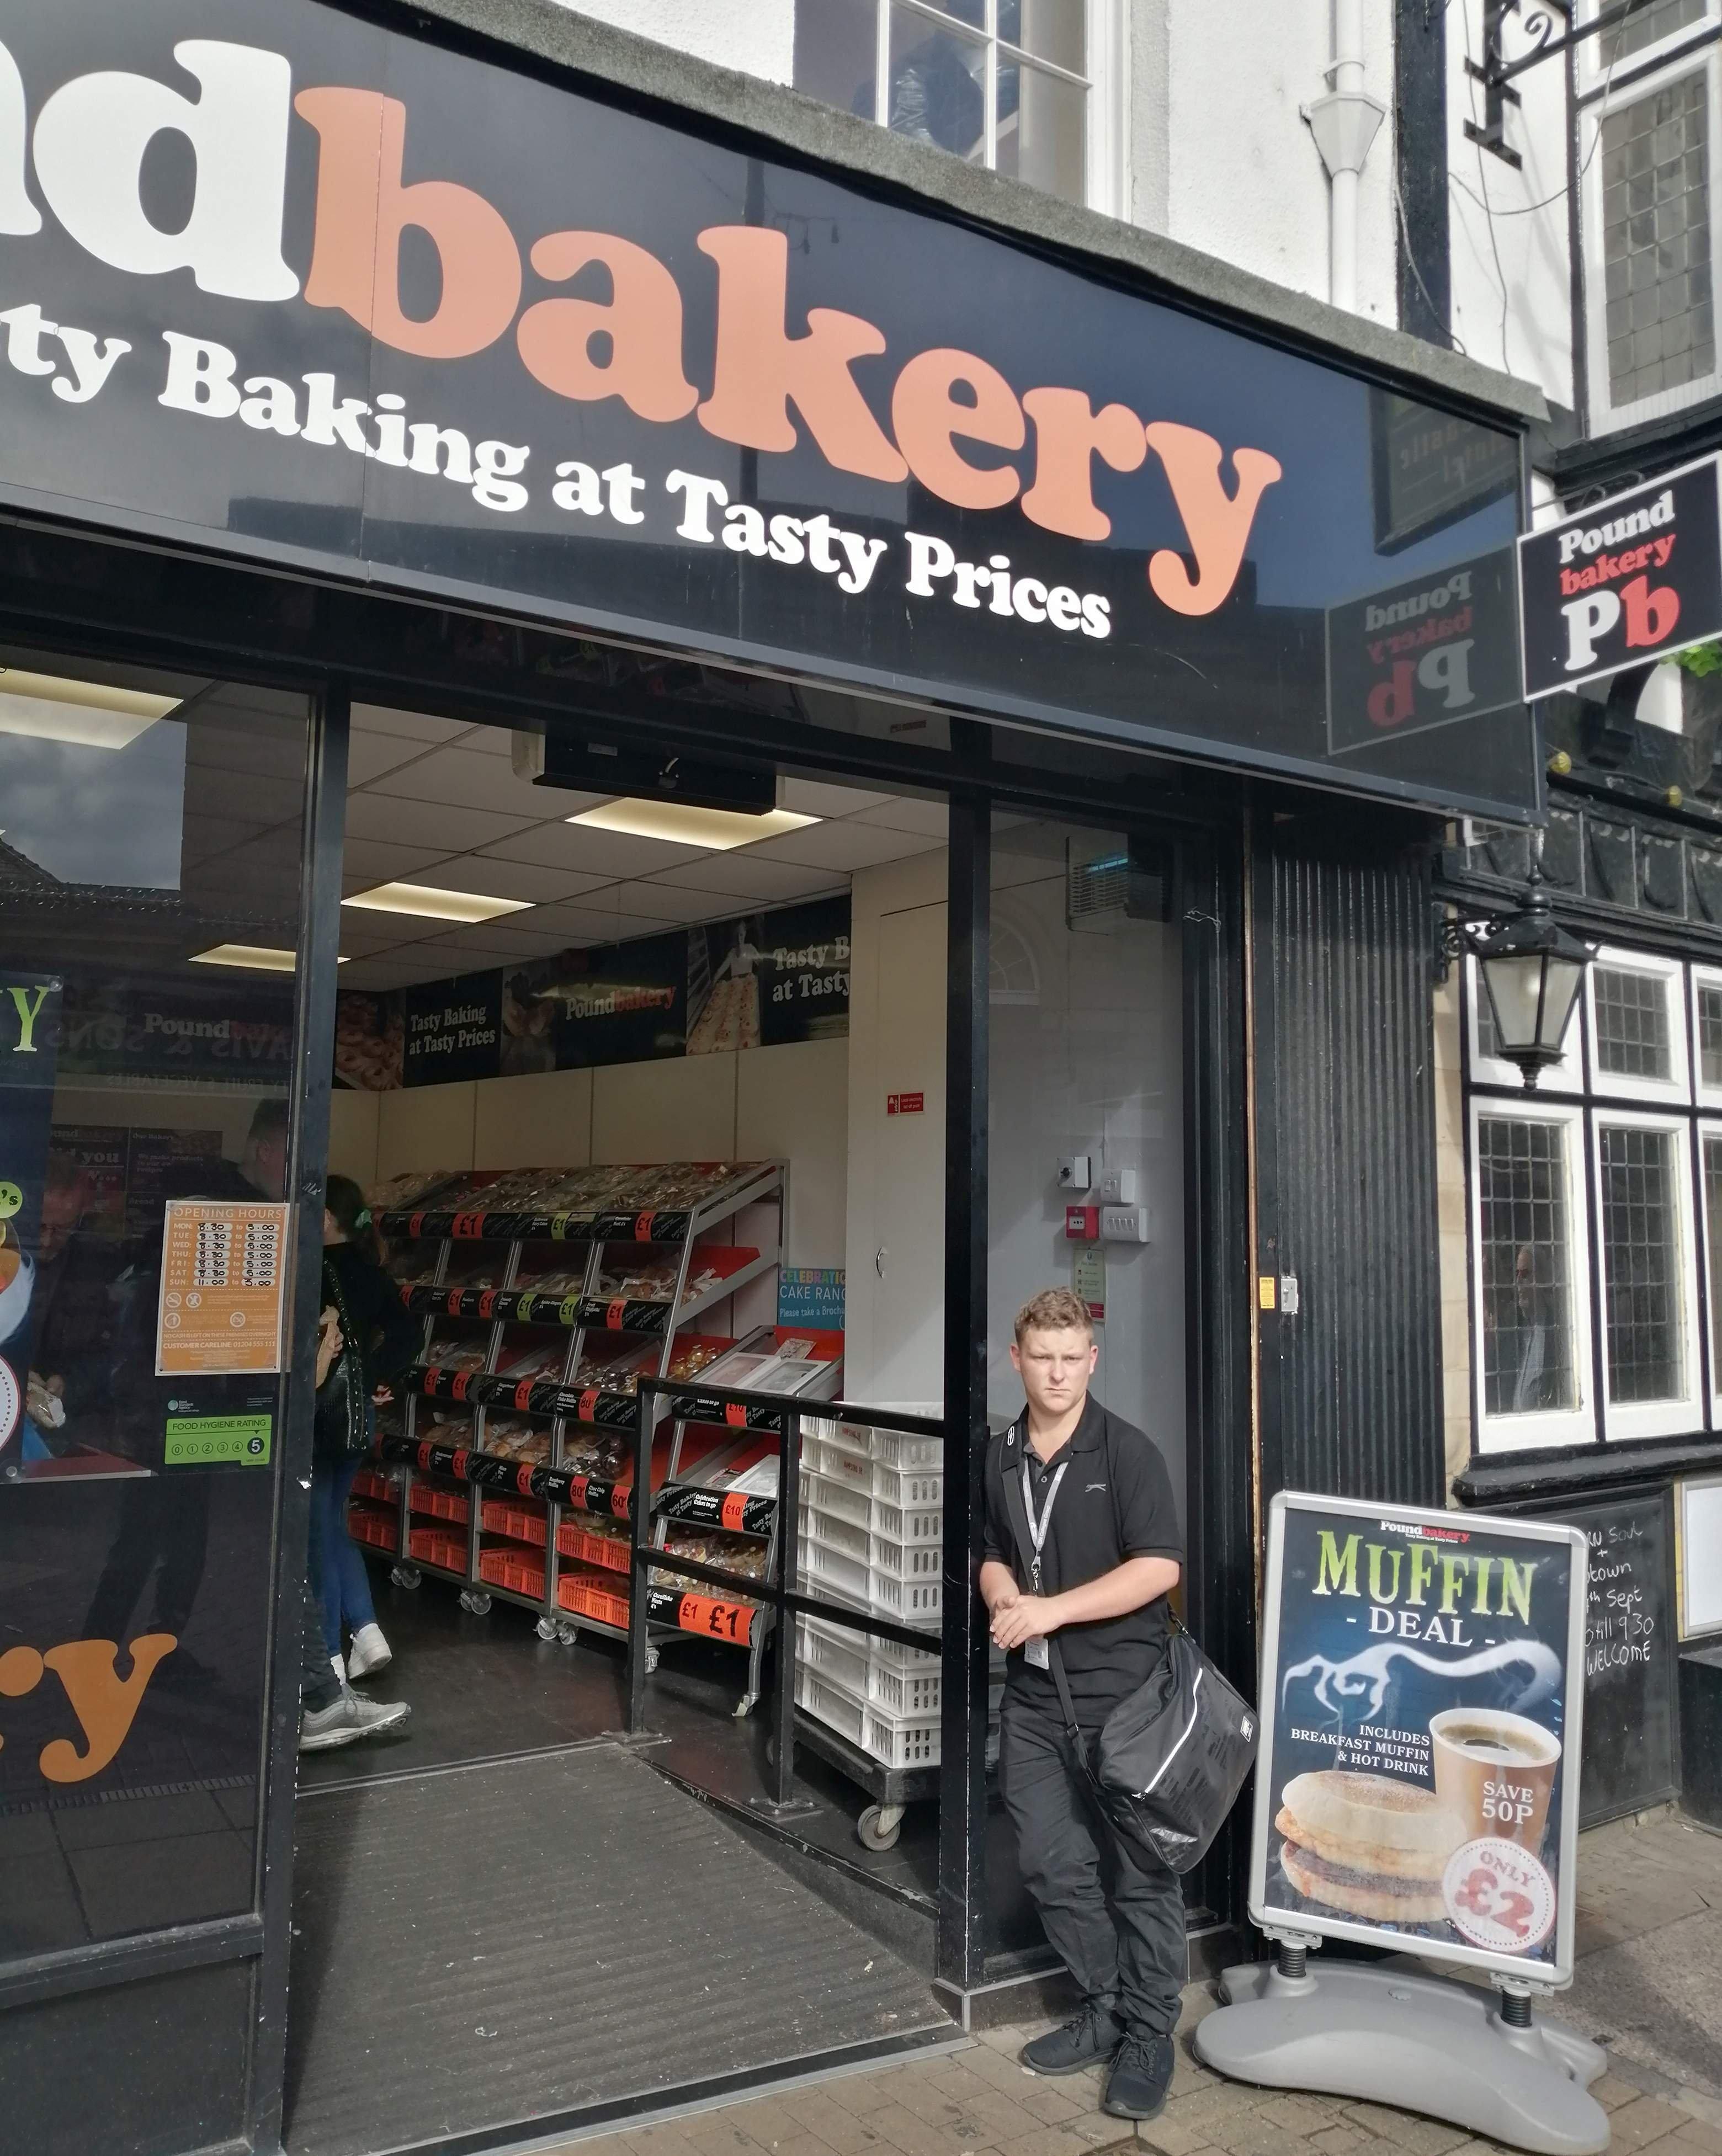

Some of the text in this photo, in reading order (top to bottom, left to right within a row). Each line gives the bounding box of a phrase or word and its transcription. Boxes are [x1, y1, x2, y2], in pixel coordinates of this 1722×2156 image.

[0, 39, 1282, 616] dbakery
[158, 331, 530, 513] Baking
[552, 460, 645, 525] at
[666, 469, 887, 594] Tasty
[905, 531, 1111, 640] Prices
[1559, 490, 1676, 564] Pound
[1560, 534, 1676, 596] bakery
[1561, 574, 1681, 672] Pb
[773, 943, 830, 972] Tasty
[772, 970, 850, 1003] at Tasty
[0, 985, 51, 1052] Y
[410, 1004, 487, 1033] Tasty Baking
[409, 1027, 496, 1056] at Tasty Prices
[174, 1207, 282, 1218] OPENING HOURS
[552, 1217, 565, 1231] £1
[459, 1215, 479, 1236] £1
[637, 1217, 650, 1232] £1
[450, 1293, 459, 1306] £1
[779, 1285, 811, 1299] CAKE
[481, 1297, 491, 1311] £1
[519, 1299, 530, 1312] £1
[561, 1303, 572, 1315] £1
[609, 1306, 622, 1318] £1
[779, 1307, 800, 1318] Please
[801, 1306, 815, 1316] take
[518, 1387, 529, 1400] £1
[172, 1419, 267, 1430] FOOD HYGIENE RATING
[251, 1439, 261, 1453] 5
[519, 1472, 529, 1487] £1
[695, 1493, 719, 1503] Celebration
[725, 1504, 741, 1516] £10
[1380, 1520, 1470, 1543] Poundbakery
[1609, 1520, 1644, 1543] Soul
[1312, 1530, 1538, 1625] MUFFIN
[1587, 1563, 1632, 1584] town
[652, 1592, 674, 1602] Cornflake
[1607, 1585, 1643, 1614] Sept
[682, 1601, 698, 1619] £1
[709, 1605, 740, 1637] £1
[1369, 1606, 1475, 1647] DEAL
[1291, 1728, 1429, 1762] BREAKFAST MUFFIN
[1359, 1724, 1431, 1747] INCLUDES
[1337, 1750, 1429, 1776] & HOT DRINK
[1483, 1781, 1533, 1803] SAVE
[1481, 1798, 1534, 1824] 50P
[1480, 1850, 1537, 1887] ONLY
[1454, 1868, 1535, 1938] £2
